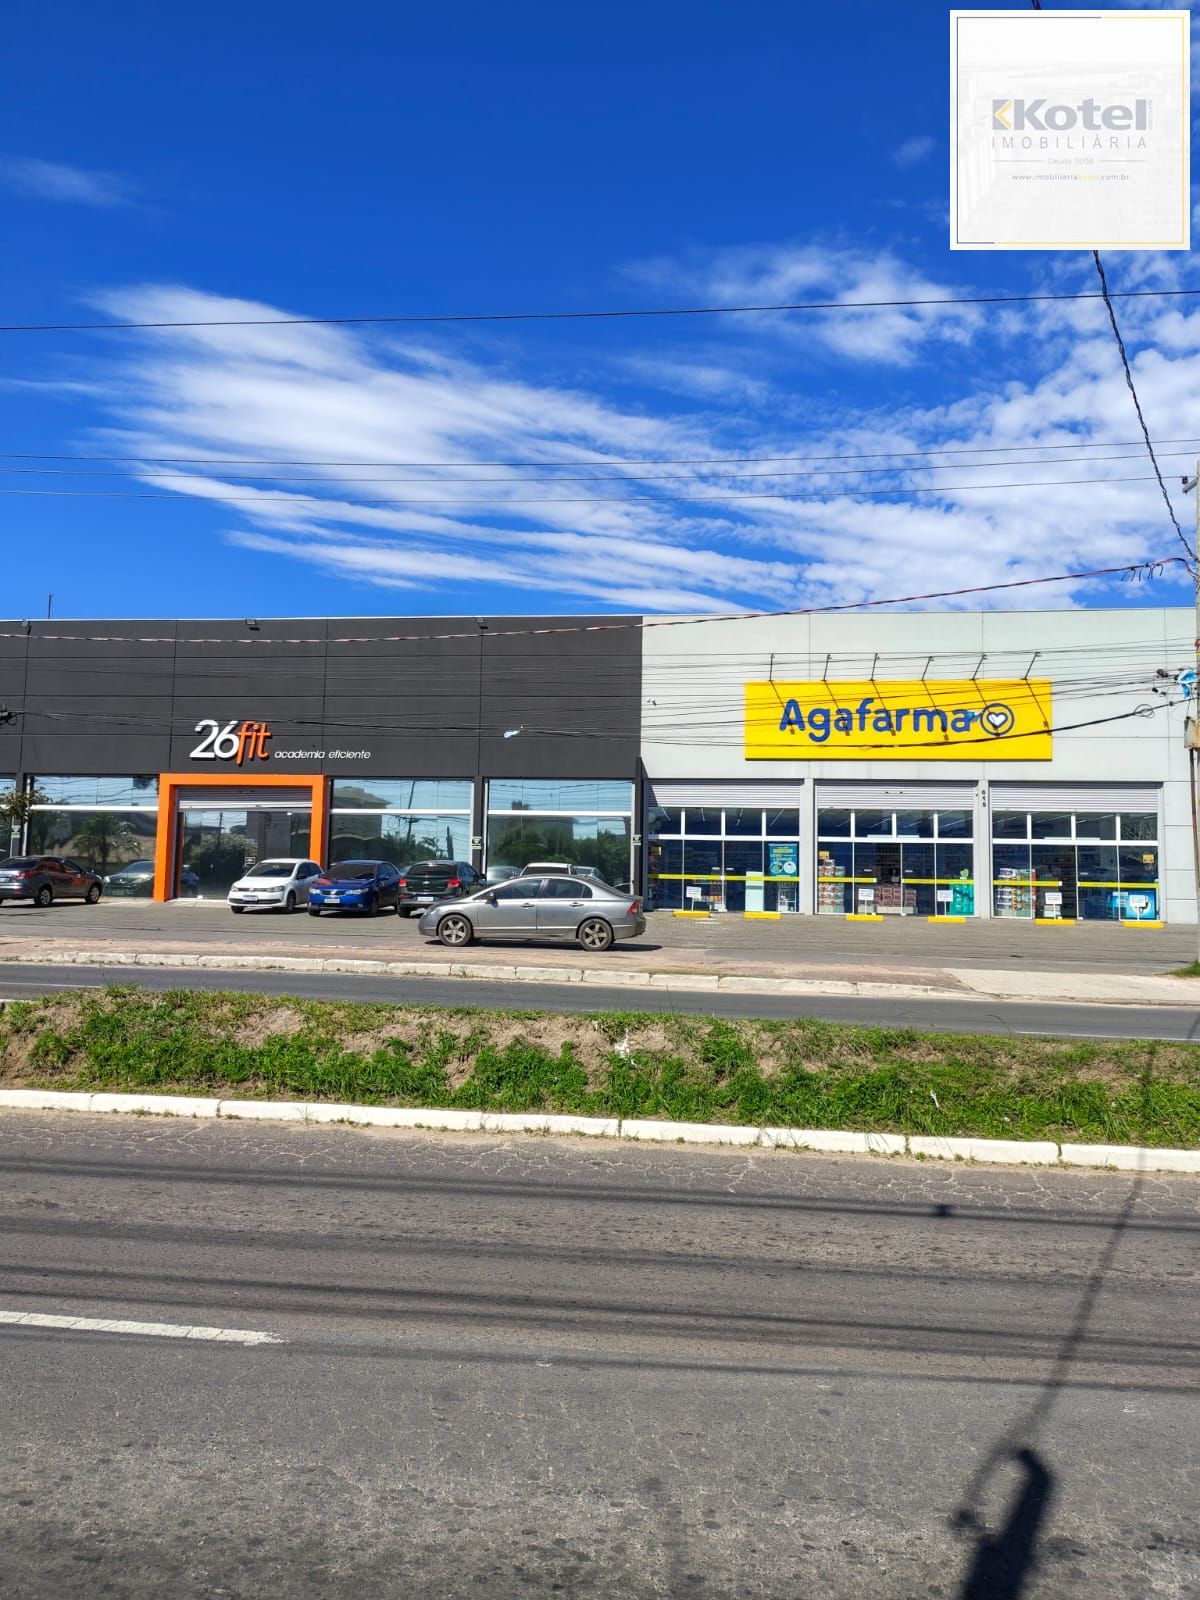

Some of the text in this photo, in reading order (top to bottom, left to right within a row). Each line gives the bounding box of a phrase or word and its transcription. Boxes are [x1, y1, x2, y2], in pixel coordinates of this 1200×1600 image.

[189, 719, 371, 765] 26fit academia eficiente
[779, 698, 971, 742] Agafarma
